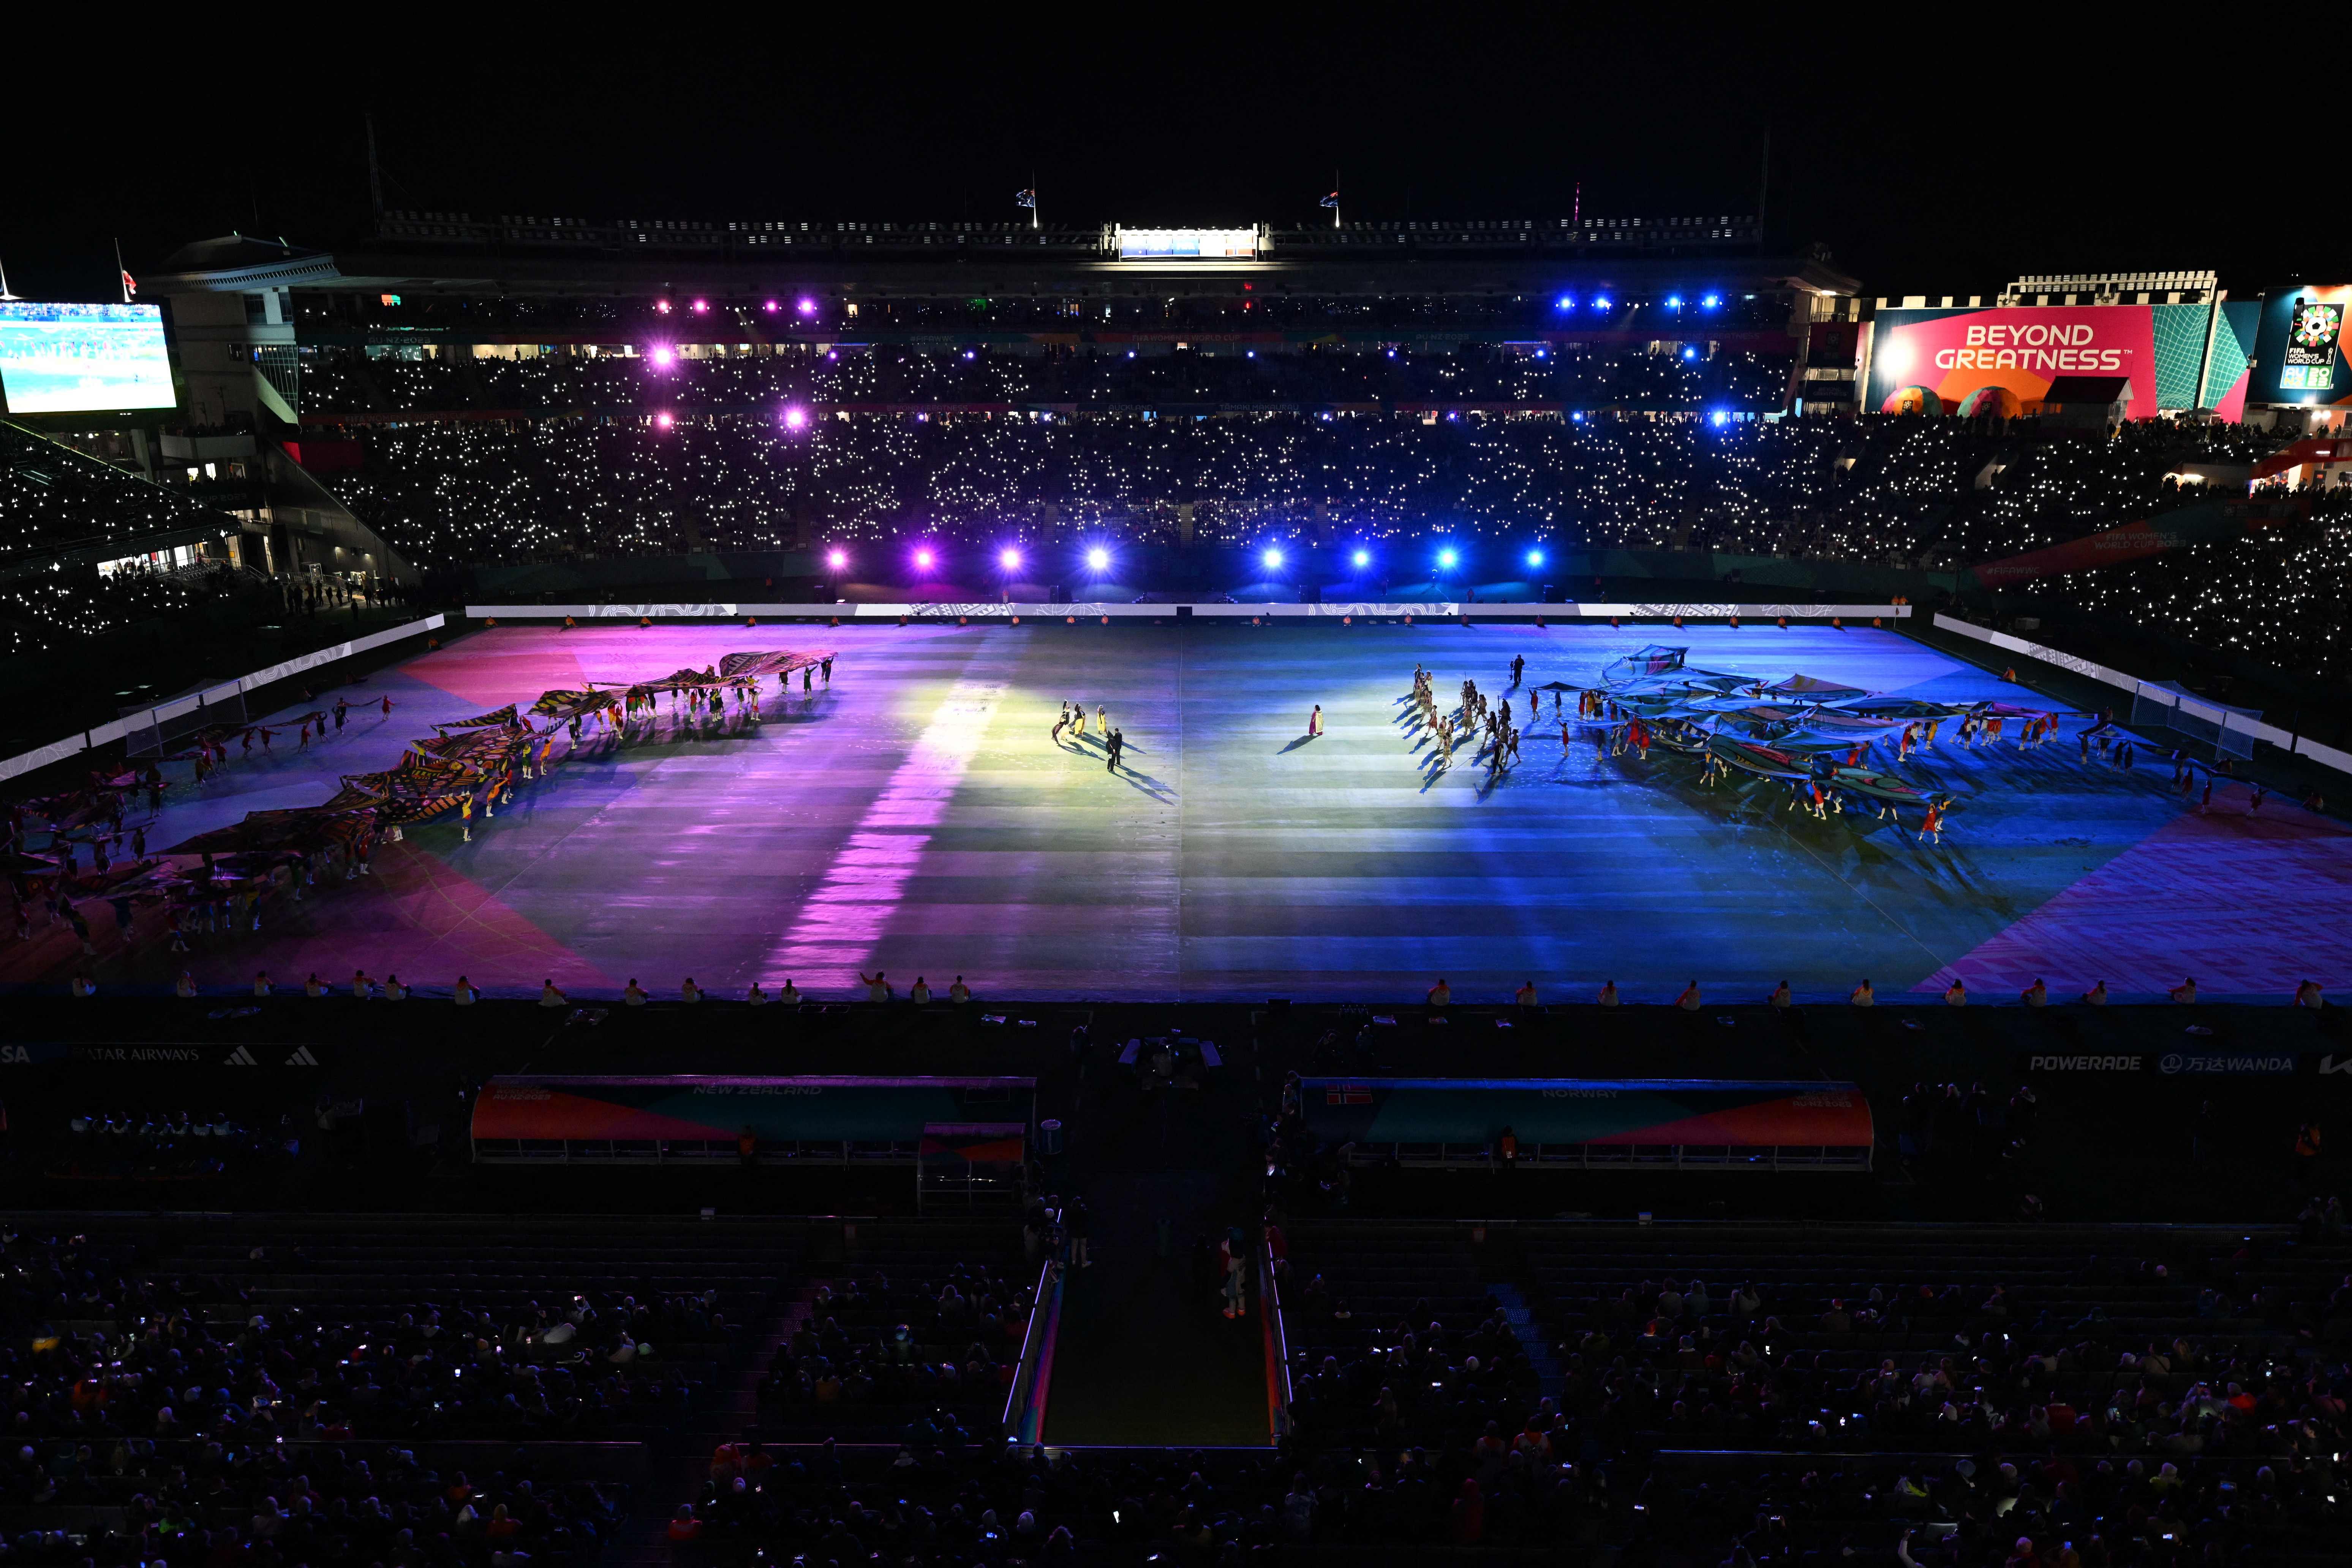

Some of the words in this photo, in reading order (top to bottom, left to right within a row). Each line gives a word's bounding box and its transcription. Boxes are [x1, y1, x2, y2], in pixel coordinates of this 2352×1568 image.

[1966, 325, 2093, 346] BEYOND
[1935, 349, 2121, 370] GREATNESS
[2285, 367, 2306, 377] AU
[2094, 541, 2131, 549] WORLD
[2134, 539, 2154, 548] CUP
[2156, 538, 2188, 547] 2023
[131, 1048, 200, 1061] AIRWAYS
[2030, 1055, 2142, 1070] POWERADE
[693, 1086, 733, 1094] NEW
[736, 1086, 822, 1095] ZEALAND
[1542, 1089, 1618, 1098] NORWAY
